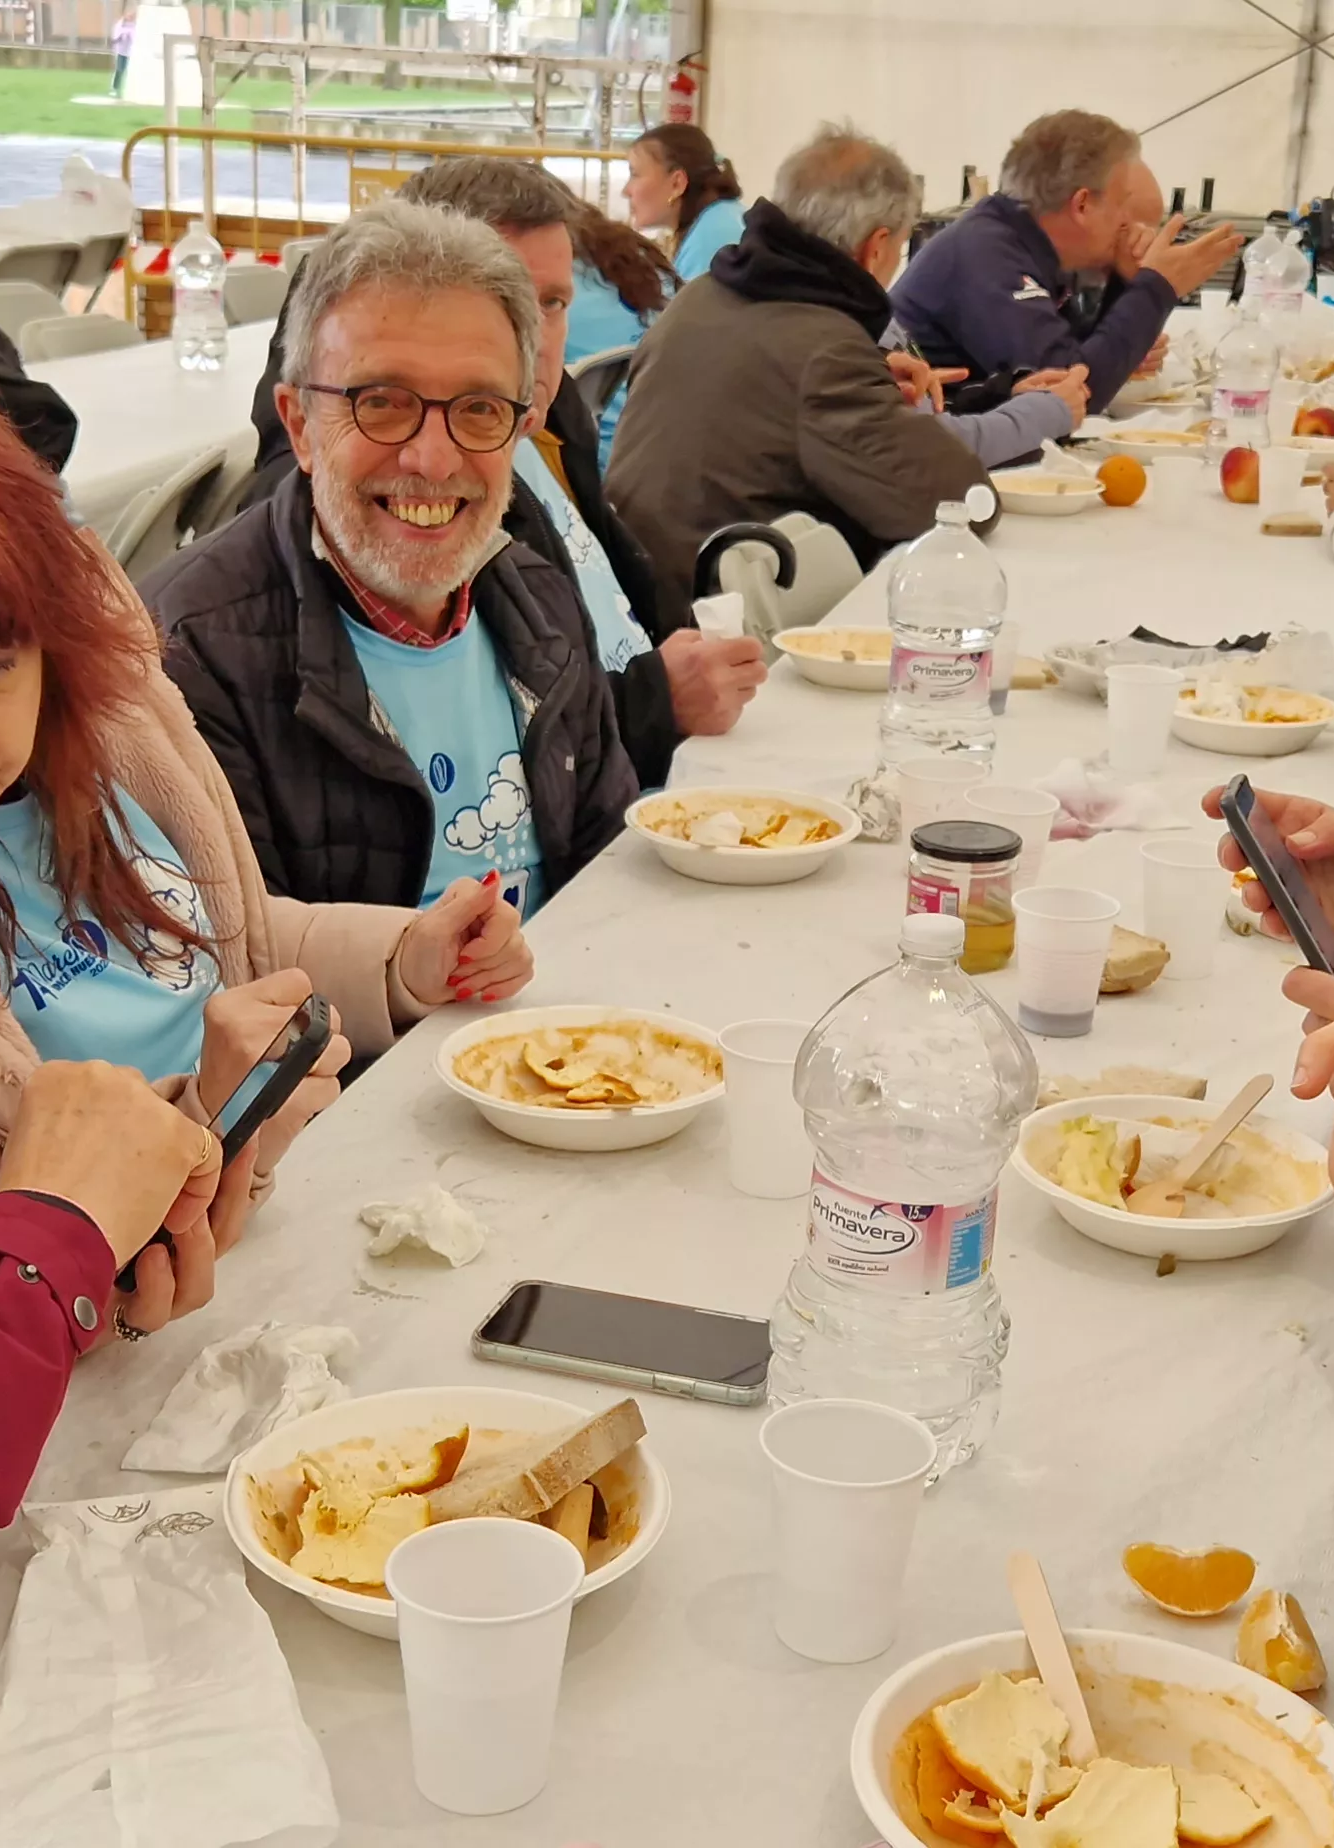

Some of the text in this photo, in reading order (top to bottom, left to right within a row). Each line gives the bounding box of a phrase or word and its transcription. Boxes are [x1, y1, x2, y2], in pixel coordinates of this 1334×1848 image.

[912, 664, 973, 676] Primavera
[813, 1194, 906, 1243] Primavera
[833, 1201, 868, 1221] fuente
